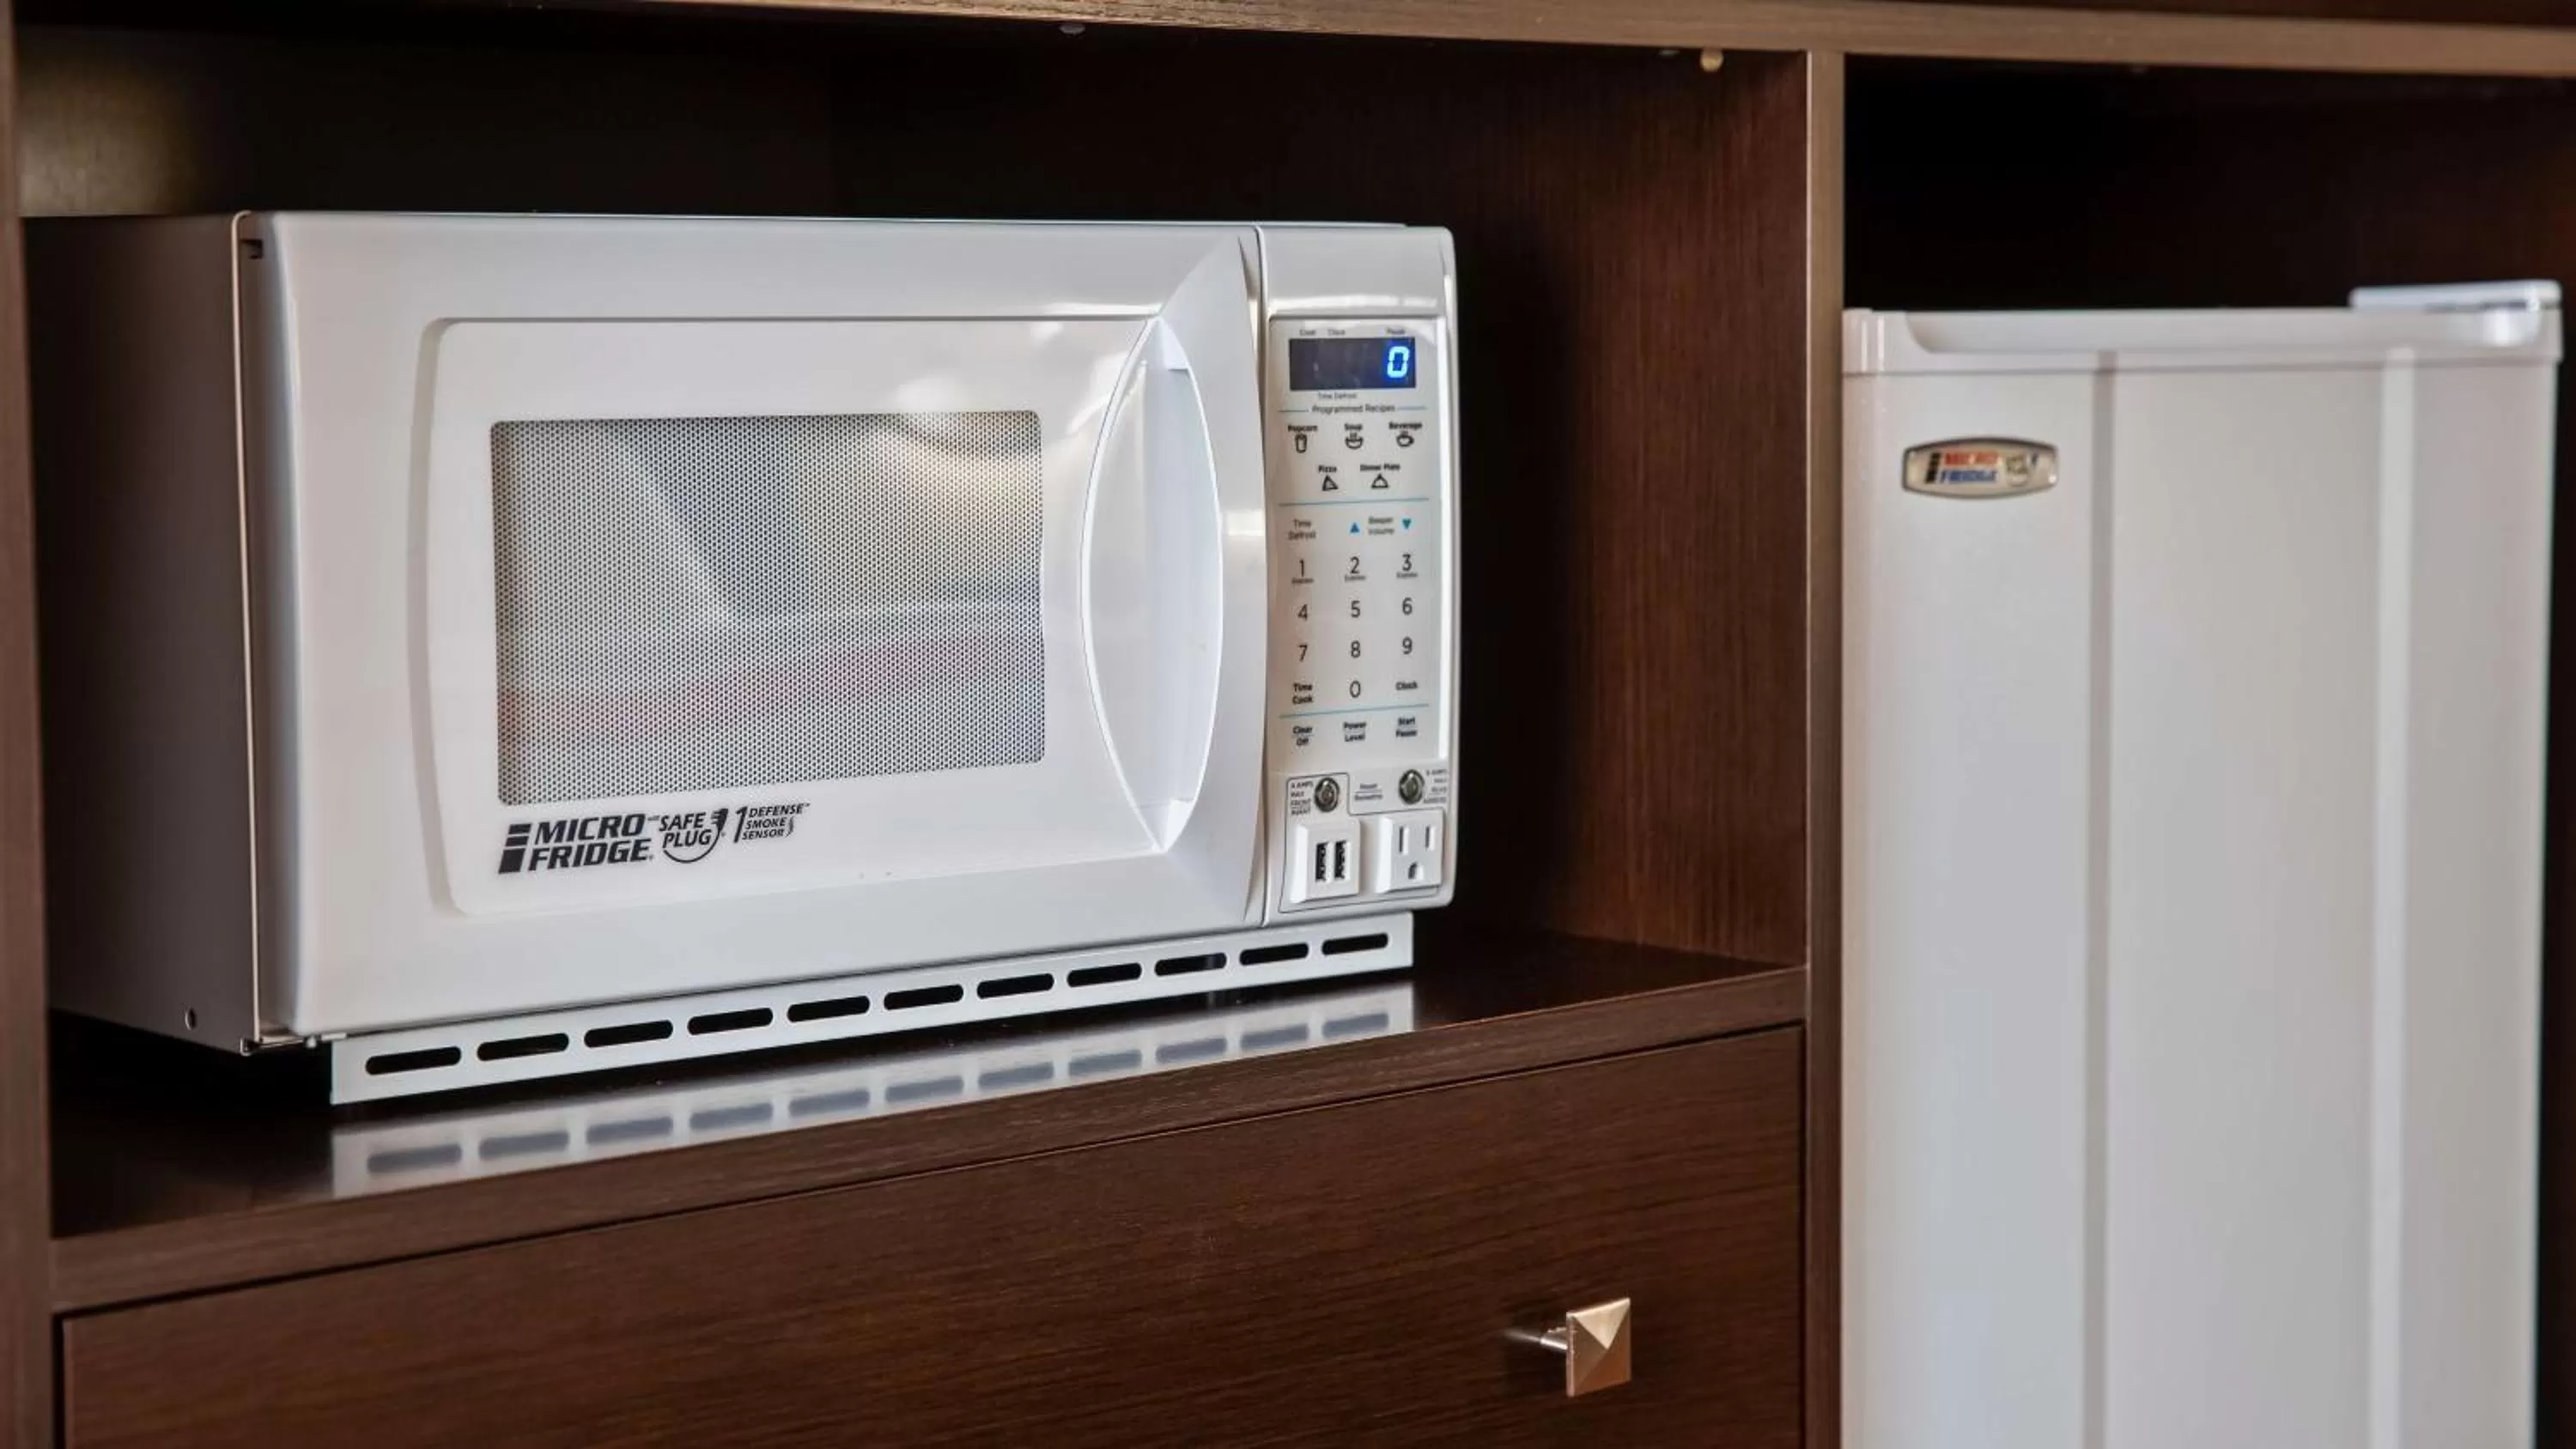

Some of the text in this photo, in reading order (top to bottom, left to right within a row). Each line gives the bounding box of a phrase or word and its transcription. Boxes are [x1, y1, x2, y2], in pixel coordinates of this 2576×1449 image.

[1386, 346, 1410, 379] 0
[1312, 404, 1396, 415] Programmed Recipes
[1344, 423, 1363, 432] Soup
[1388, 421, 1423, 431] Beverage
[1318, 464, 1337, 473] Pizza
[1293, 519, 1312, 529] Time
[1369, 517, 1393, 525] Beeper
[1288, 530, 1316, 540] Defrost
[1369, 527, 1394, 536] Volume
[1298, 559, 1306, 578] 1
[1350, 556, 1361, 574] 2
[1401, 554, 1413, 572] 3
[1350, 600, 1361, 619] 5
[1401, 597, 1413, 615] 6
[1297, 603, 1309, 621] 4
[1350, 640, 1361, 659] 8
[1401, 636, 1413, 655] 9
[1297, 644, 1309, 662] 7
[1292, 682, 1312, 693] Time
[1349, 680, 1362, 698] 0
[1395, 681, 1419, 691] Clock
[1291, 694, 1313, 705] Cook
[1343, 721, 1367, 731] Power
[1397, 717, 1416, 726] Start
[1292, 725, 1313, 735] Clear
[1395, 729, 1418, 738] Pause
[1296, 737, 1309, 747] Off
[1344, 732, 1365, 743] Level
[659, 812, 707, 833] SAFE
[733, 803, 805, 843] 1 DEFENSE
[745, 817, 787, 828] SMOKE
[534, 814, 647, 846] MICRO
[741, 828, 785, 840] SENSOR
[663, 829, 712, 849] PLUG
[527, 838, 651, 871] FRIDGE
